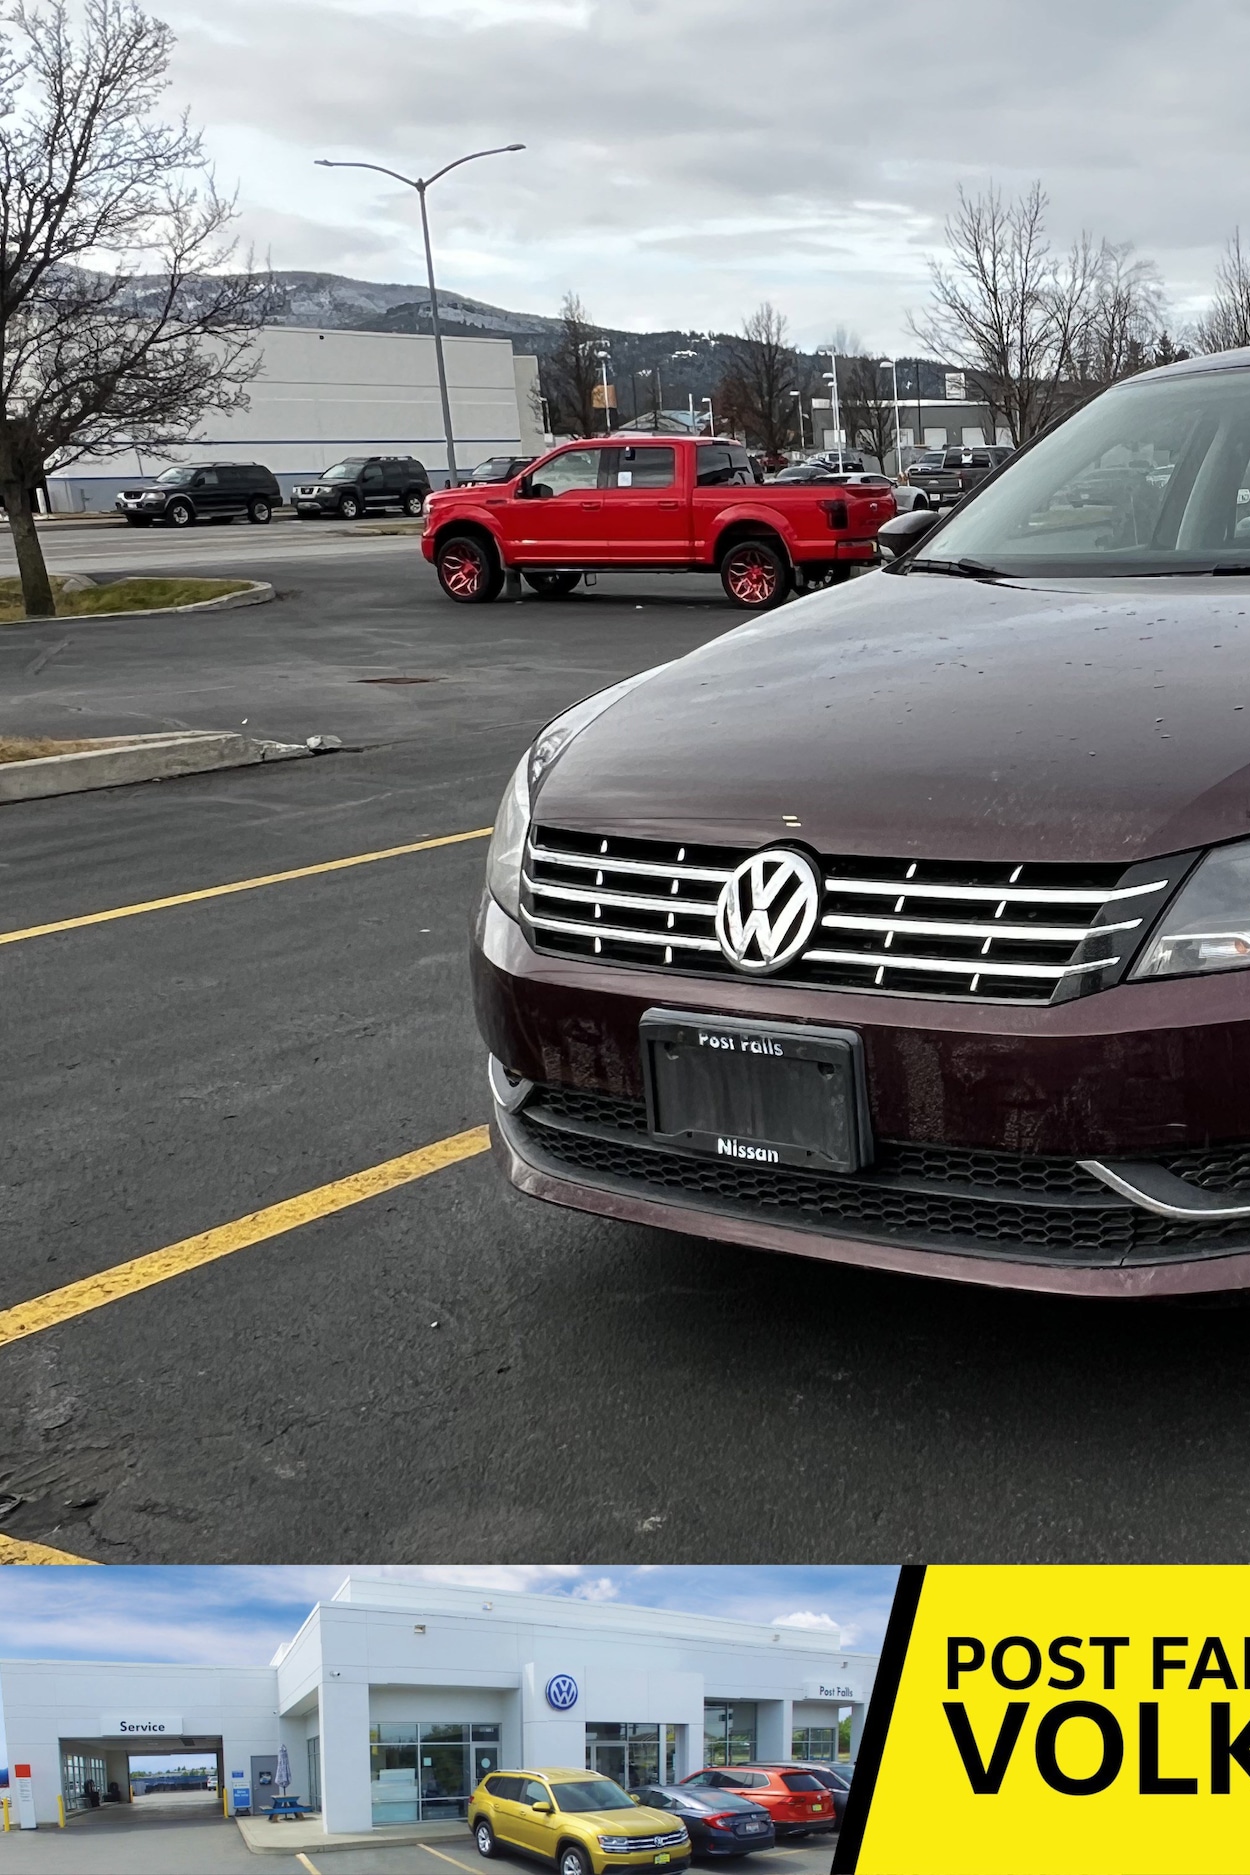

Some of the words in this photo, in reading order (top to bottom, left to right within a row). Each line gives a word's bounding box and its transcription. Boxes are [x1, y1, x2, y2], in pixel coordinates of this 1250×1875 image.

[698, 1033, 735, 1050] Post
[741, 1036, 784, 1056] Falls
[717, 1138, 779, 1163] Nissan
